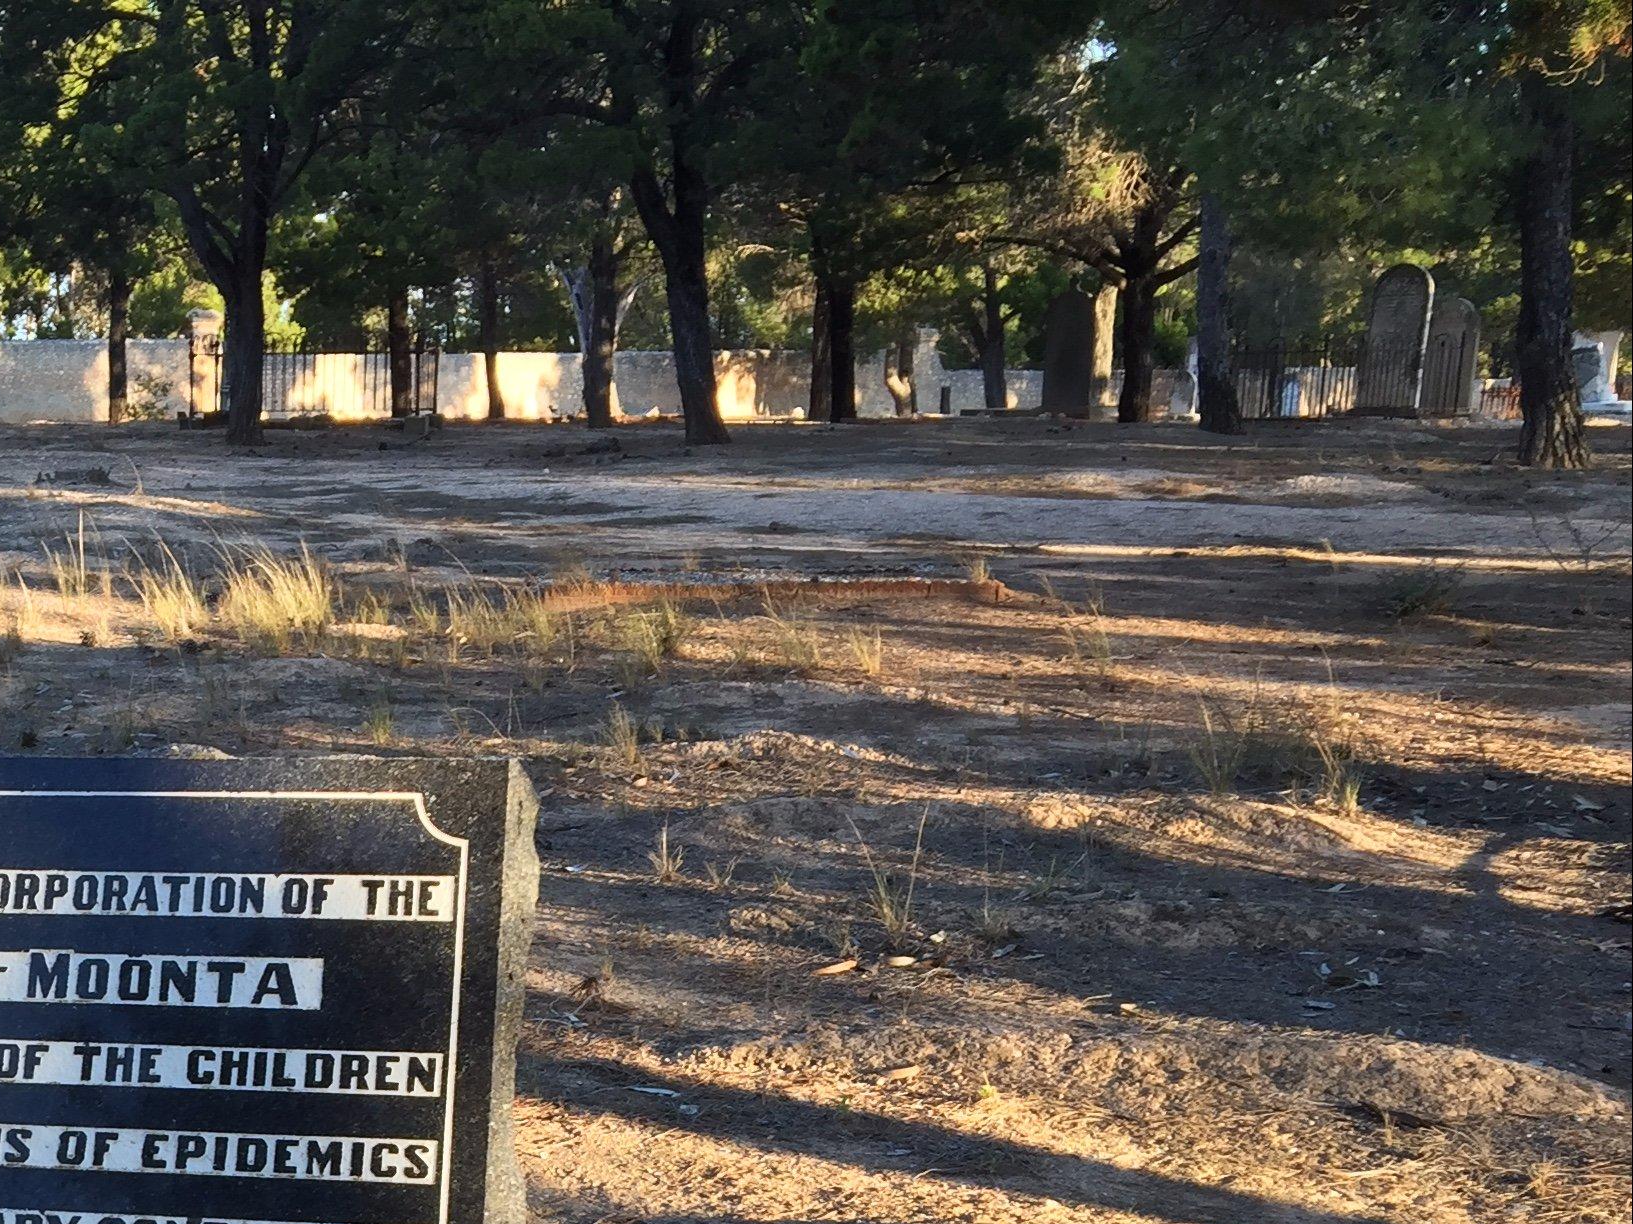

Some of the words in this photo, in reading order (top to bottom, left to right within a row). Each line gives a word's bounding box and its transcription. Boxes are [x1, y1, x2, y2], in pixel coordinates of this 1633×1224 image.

[280, 878, 333, 915] OF
[361, 879, 441, 917] THE
[26, 952, 300, 1006] MOONTA
[73, 1043, 164, 1084] THE
[186, 1049, 440, 1092] CHILDREN
[56, 1130, 118, 1167] OF
[140, 1135, 430, 1179] EPIDEMICS
